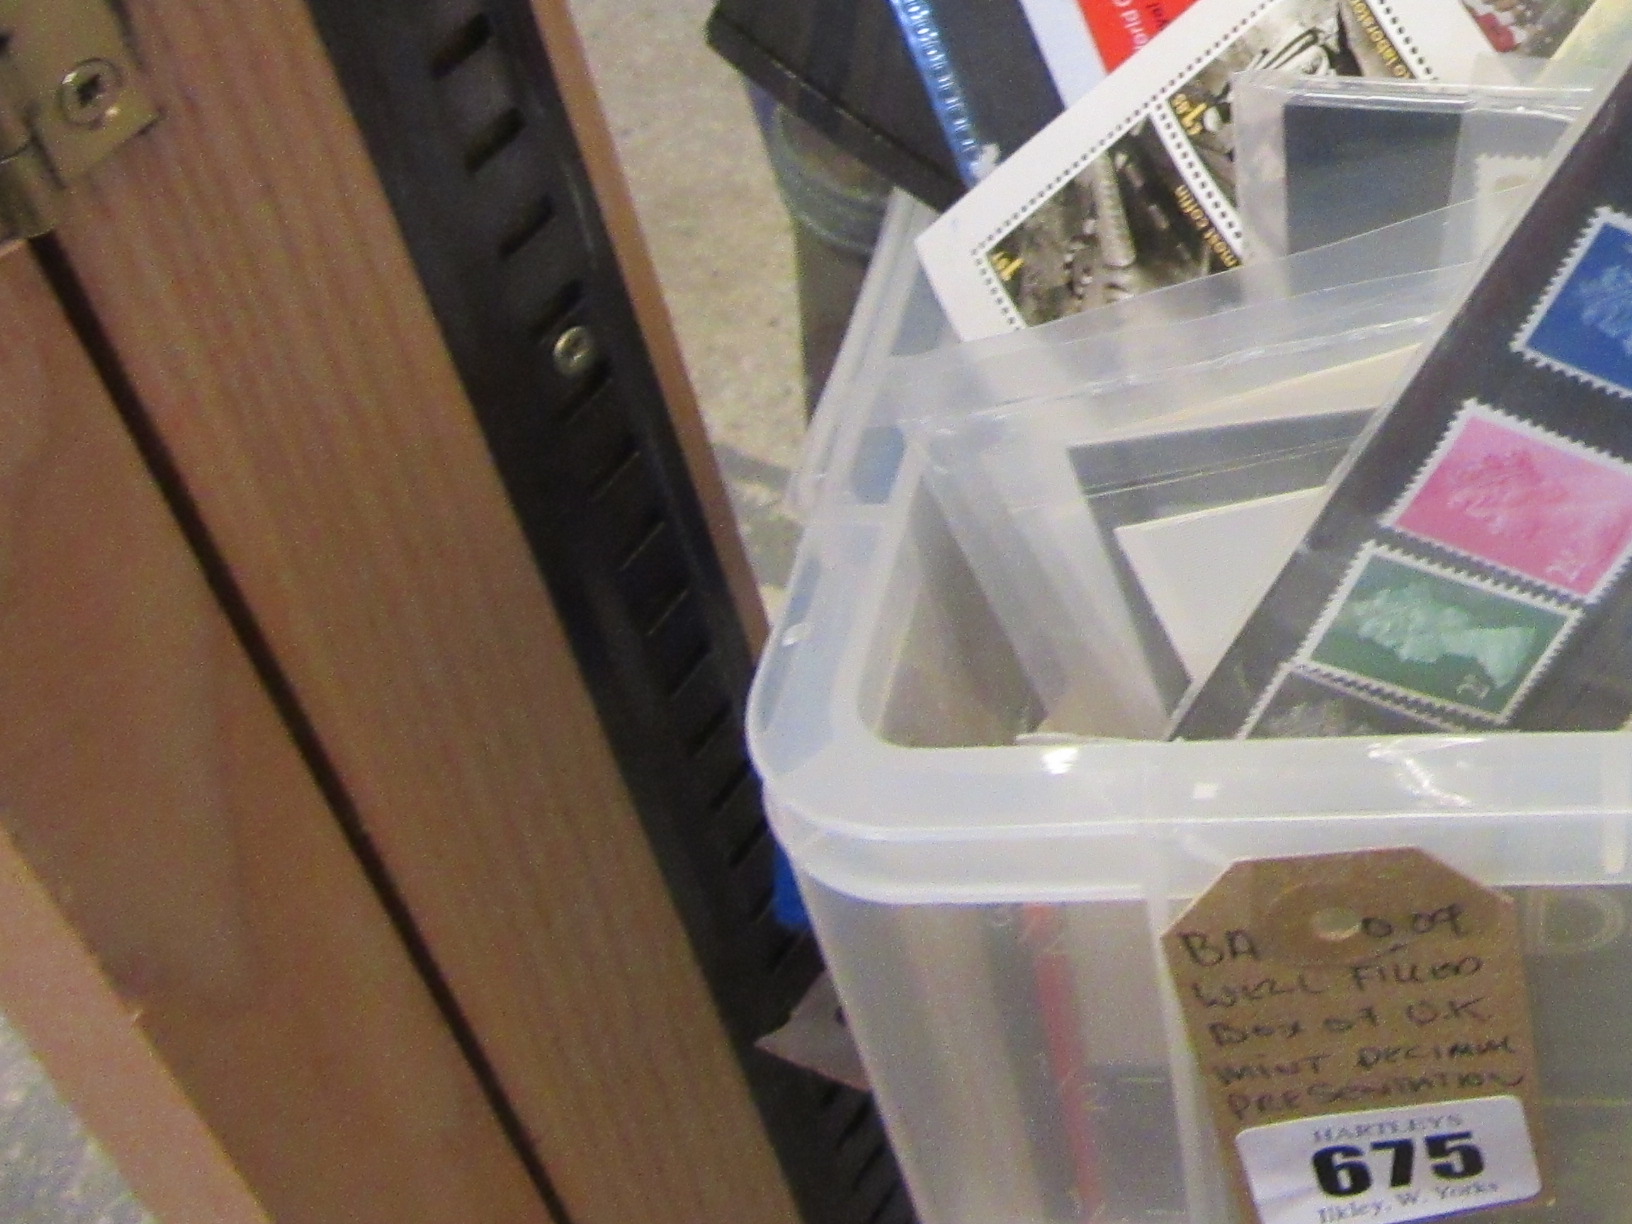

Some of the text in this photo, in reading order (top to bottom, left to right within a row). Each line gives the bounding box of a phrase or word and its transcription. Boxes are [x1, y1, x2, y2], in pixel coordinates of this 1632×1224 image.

[1120, 9, 1150, 52] orld
[1174, 184, 1210, 230] coffin
[1313, 1113, 1463, 1143] HARTLEYS
[1312, 1130, 1485, 1198] 675
